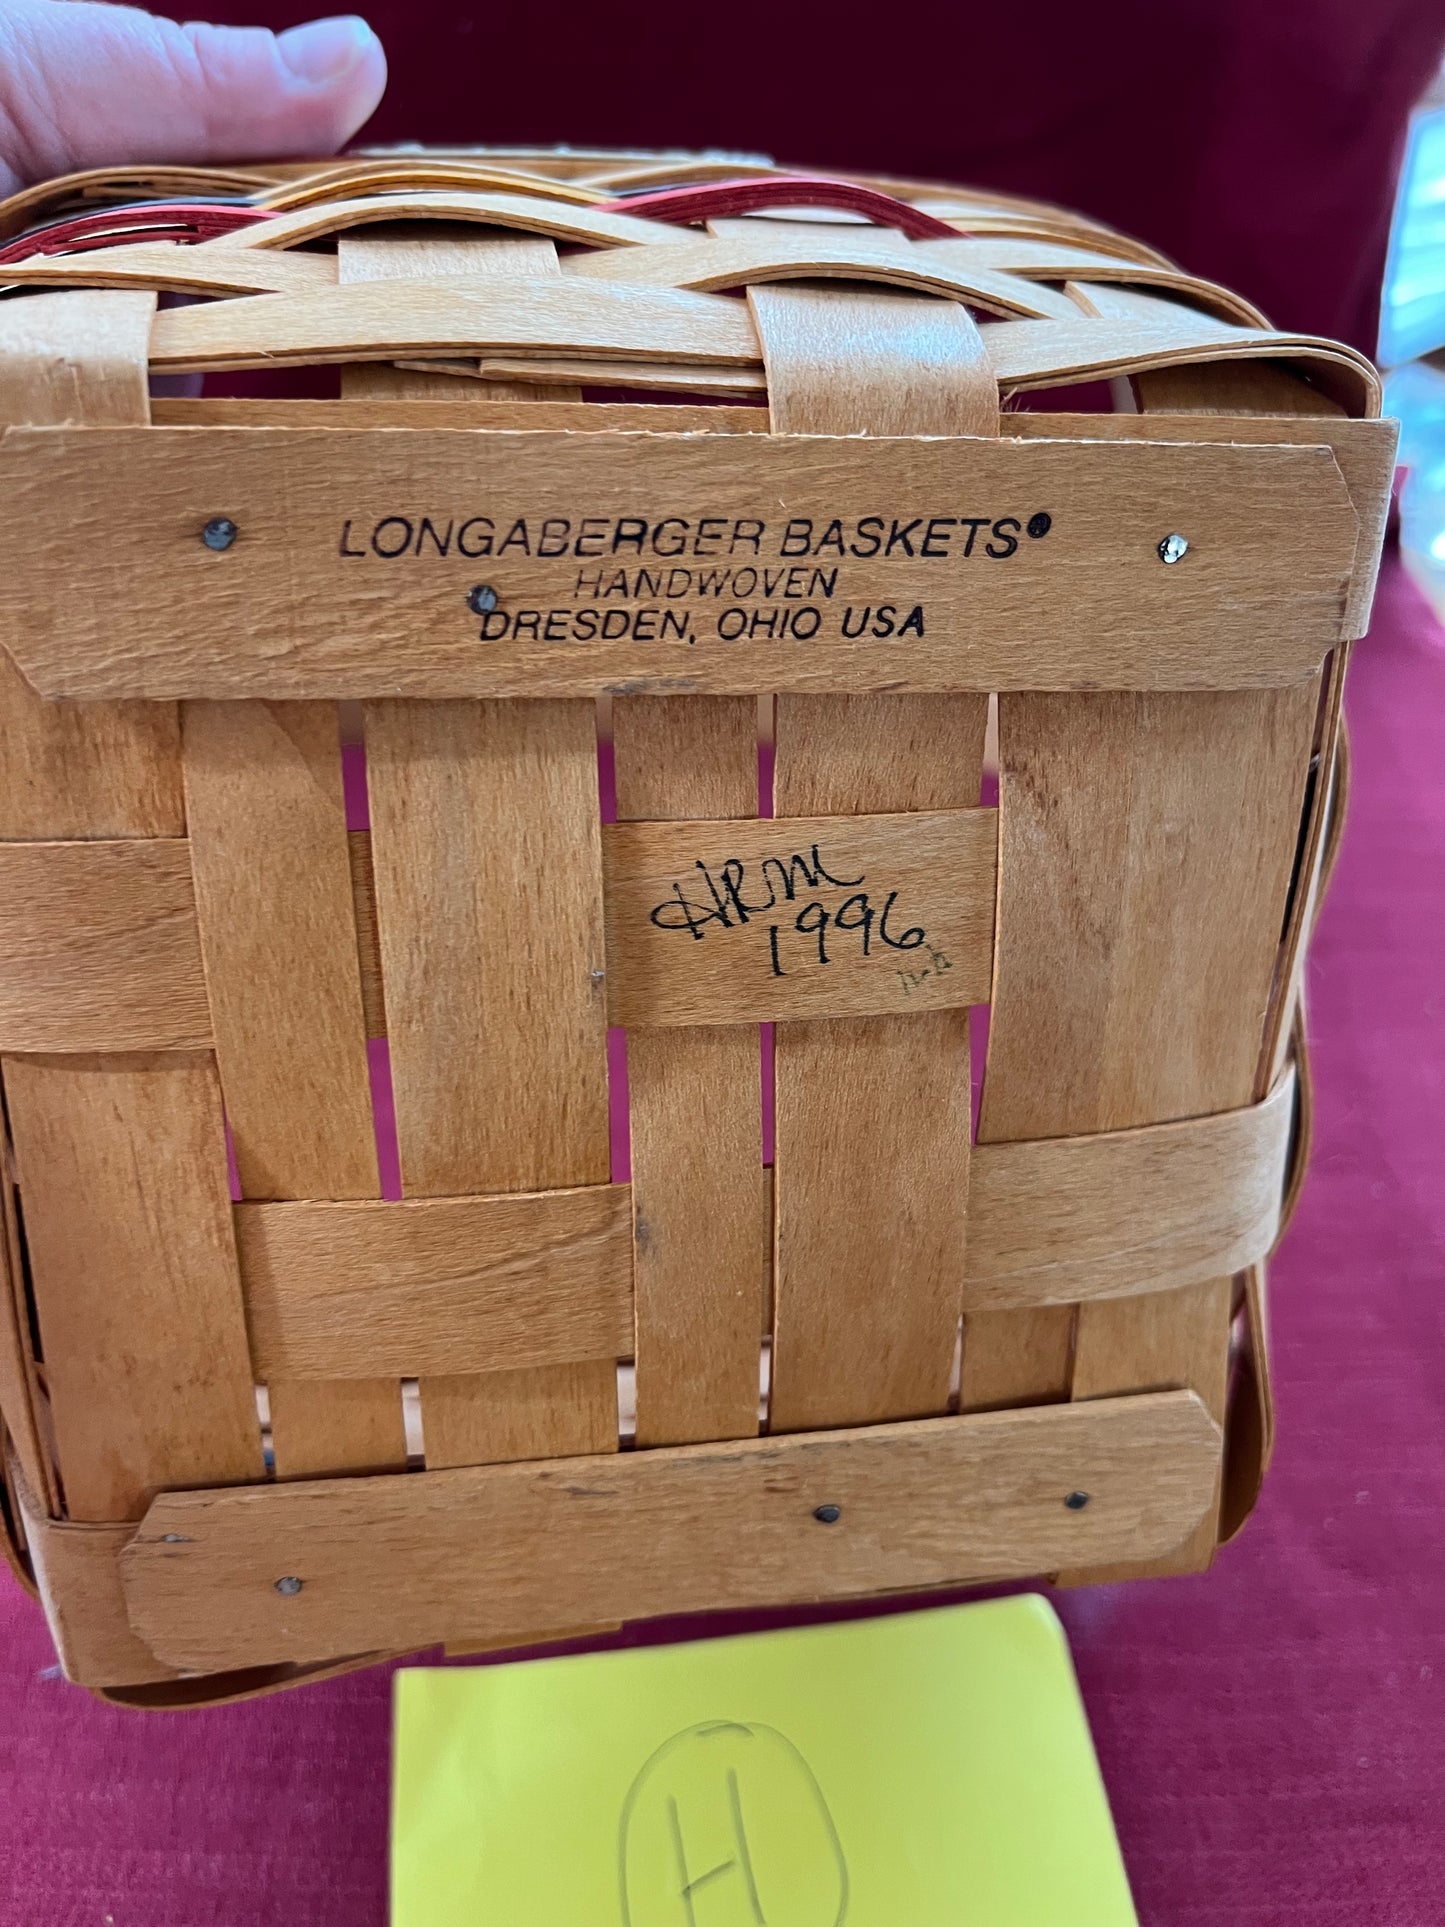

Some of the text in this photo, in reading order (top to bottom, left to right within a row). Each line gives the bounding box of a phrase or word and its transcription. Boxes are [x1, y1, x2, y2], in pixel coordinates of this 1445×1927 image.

[339, 516, 766, 558] LONGABERGER
[575, 567, 839, 599] HANDWOVEN
[479, 605, 925, 645] DRESDEN, OHIO USA
[769, 891, 925, 976] 1996
[667, 1767, 767, 1927] H
